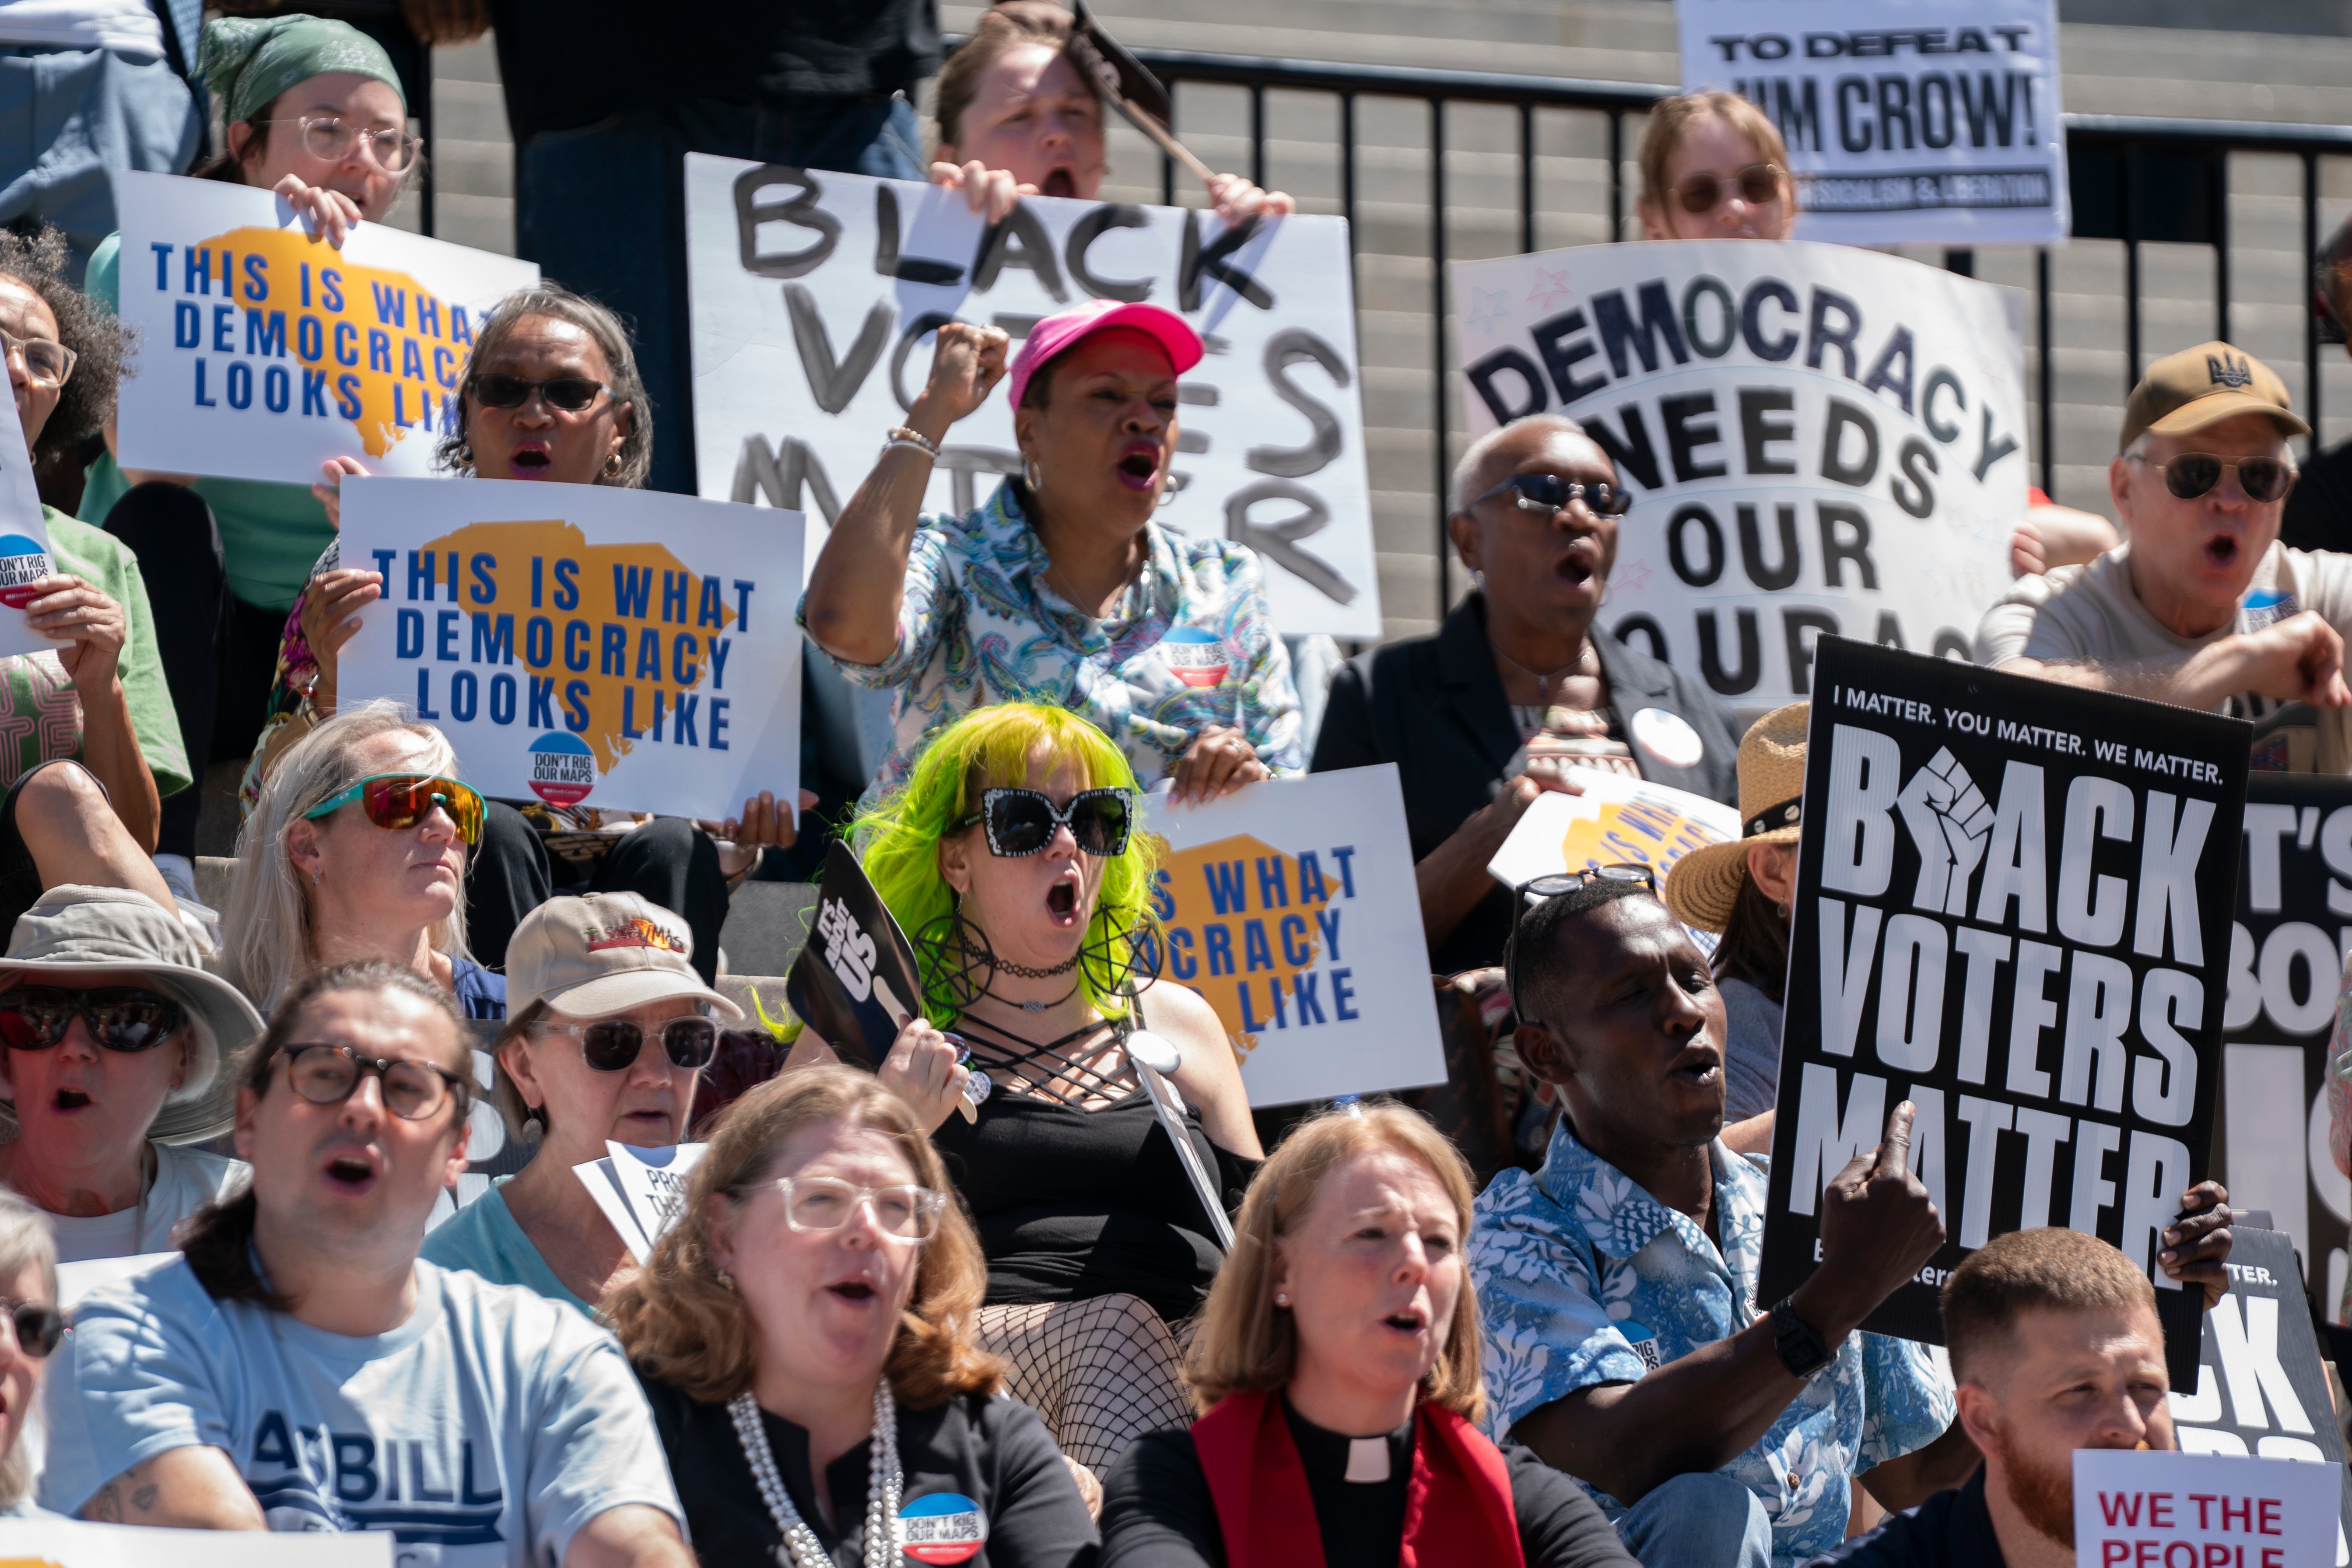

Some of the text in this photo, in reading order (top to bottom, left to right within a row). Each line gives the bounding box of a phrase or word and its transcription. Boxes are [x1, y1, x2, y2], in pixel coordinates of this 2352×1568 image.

[1709, 26, 2029, 61] TO DEFEAT
[1837, 68, 2037, 152] CROW!
[1915, 175, 1940, 201] &
[734, 163, 1278, 312] BLACK
[151, 242, 269, 301] THIS
[300, 261, 344, 312] IS
[175, 298, 470, 389] DEMOCRAC
[195, 357, 363, 421] LOOKS
[1464, 274, 2018, 482] DEMOCRACY
[1581, 387, 1939, 519] NEEDS
[0, 554, 46, 572] ON'T RIG
[0, 572, 17, 586] UR
[1667, 501, 1880, 592] OUR
[372, 548, 755, 633] THIS IS WHAT
[396, 607, 732, 690] DEMOCRACY
[417, 667, 730, 751] LOOKS LIKE
[1833, 685, 2224, 786] I MATTER. YOU MATTER. WE MATTER.
[534, 766, 592, 782] OUR MAPS
[535, 753, 590, 769] DON'T RIG
[1032, 792, 1044, 800] THE
[1006, 845, 1043, 856] WEIRDOS
[1081, 844, 1113, 856] WEIRDOS
[1203, 845, 1355, 914] WHAT
[2242, 803, 2352, 916] T'S
[834, 915, 876, 1002] US
[1237, 968, 1359, 1033] LIKE
[1817, 896, 2205, 1127] VOTERS
[2229, 1263, 2278, 1287] TER.
[906, 1526, 978, 1541] OUR MAPS
[907, 1512, 976, 1529] DON'T RIG
[2098, 1491, 2283, 1536] WE THE
[2101, 1539, 2285, 1568] PEOPLE
